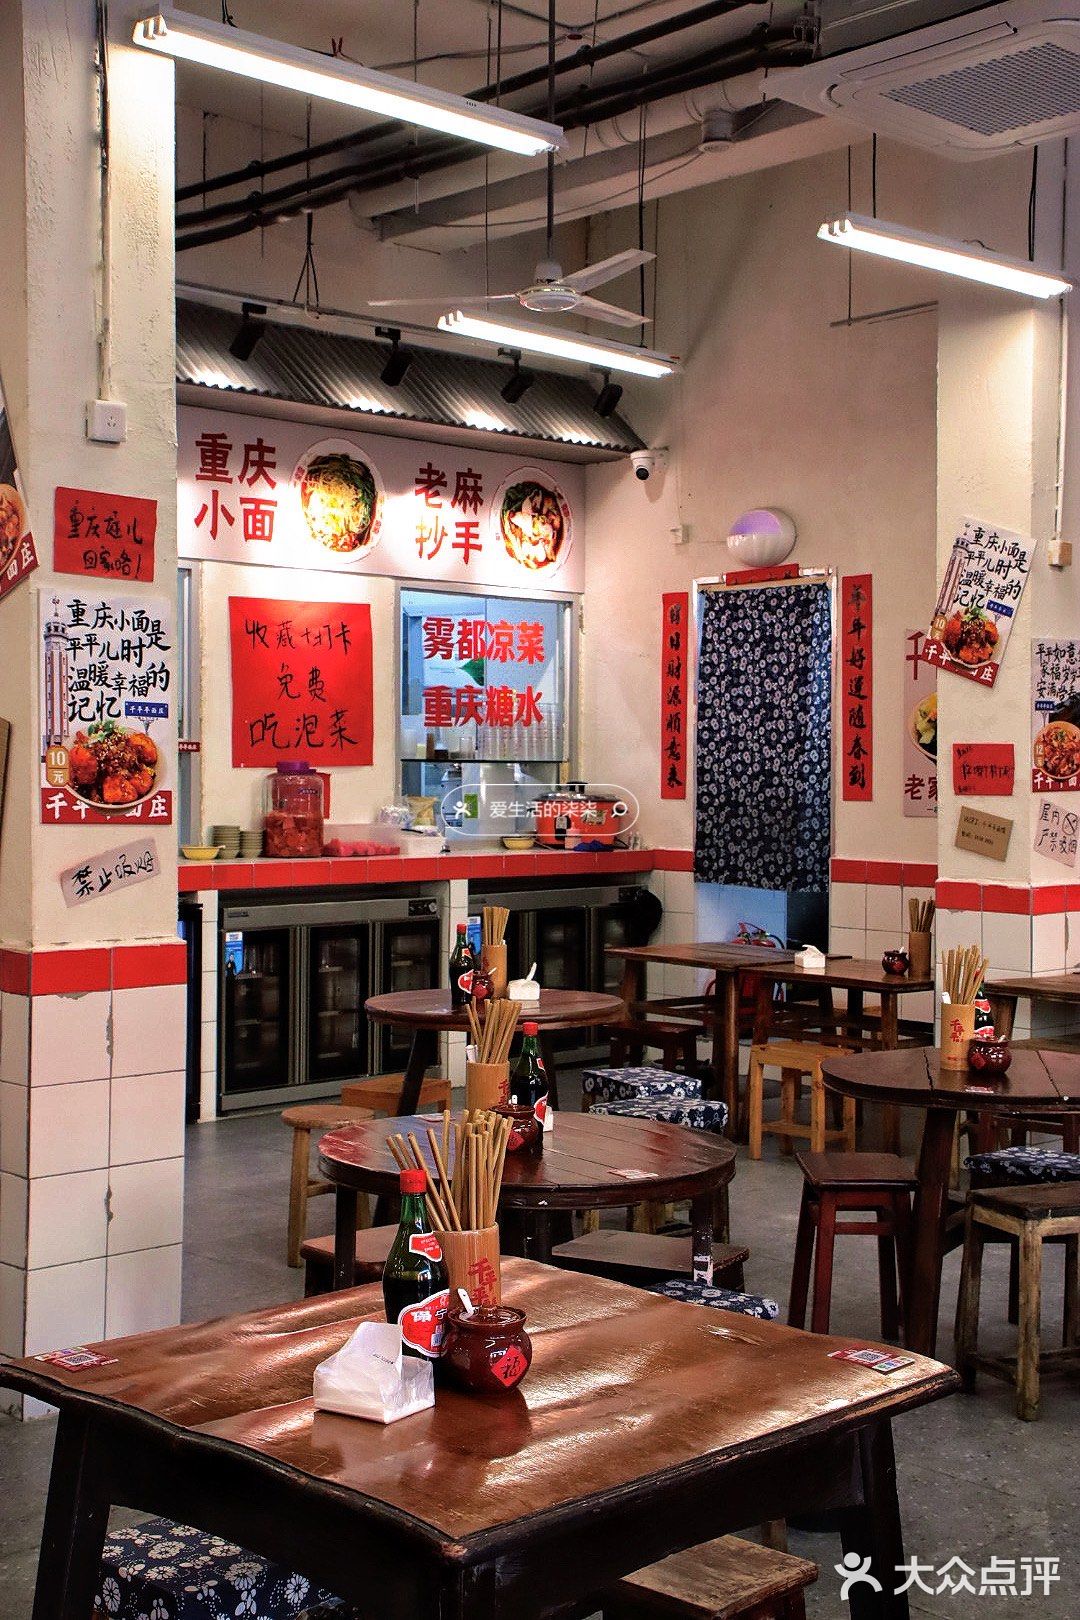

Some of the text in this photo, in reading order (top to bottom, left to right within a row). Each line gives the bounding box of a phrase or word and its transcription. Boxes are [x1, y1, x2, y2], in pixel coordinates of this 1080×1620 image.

[195, 433, 277, 490] 重庆
[414, 462, 484, 516] 老麻
[194, 490, 278, 542] 小面
[415, 515, 484, 565] 抄手
[969, 527, 1028, 573] 重庆小面是
[953, 586, 985, 609] 记忆
[67, 599, 171, 651] 重庆小面是
[422, 616, 545, 665] 雾都凉菜
[67, 661, 170, 698] 温暖幸福的
[277, 662, 327, 702] 免费
[67, 690, 121, 722] 记忆
[422, 685, 544, 727] 重庆糖水
[249, 709, 359, 750] 吃泡菜
[50, 751, 66, 766] 10
[71, 850, 154, 899] 禁止吸烟
